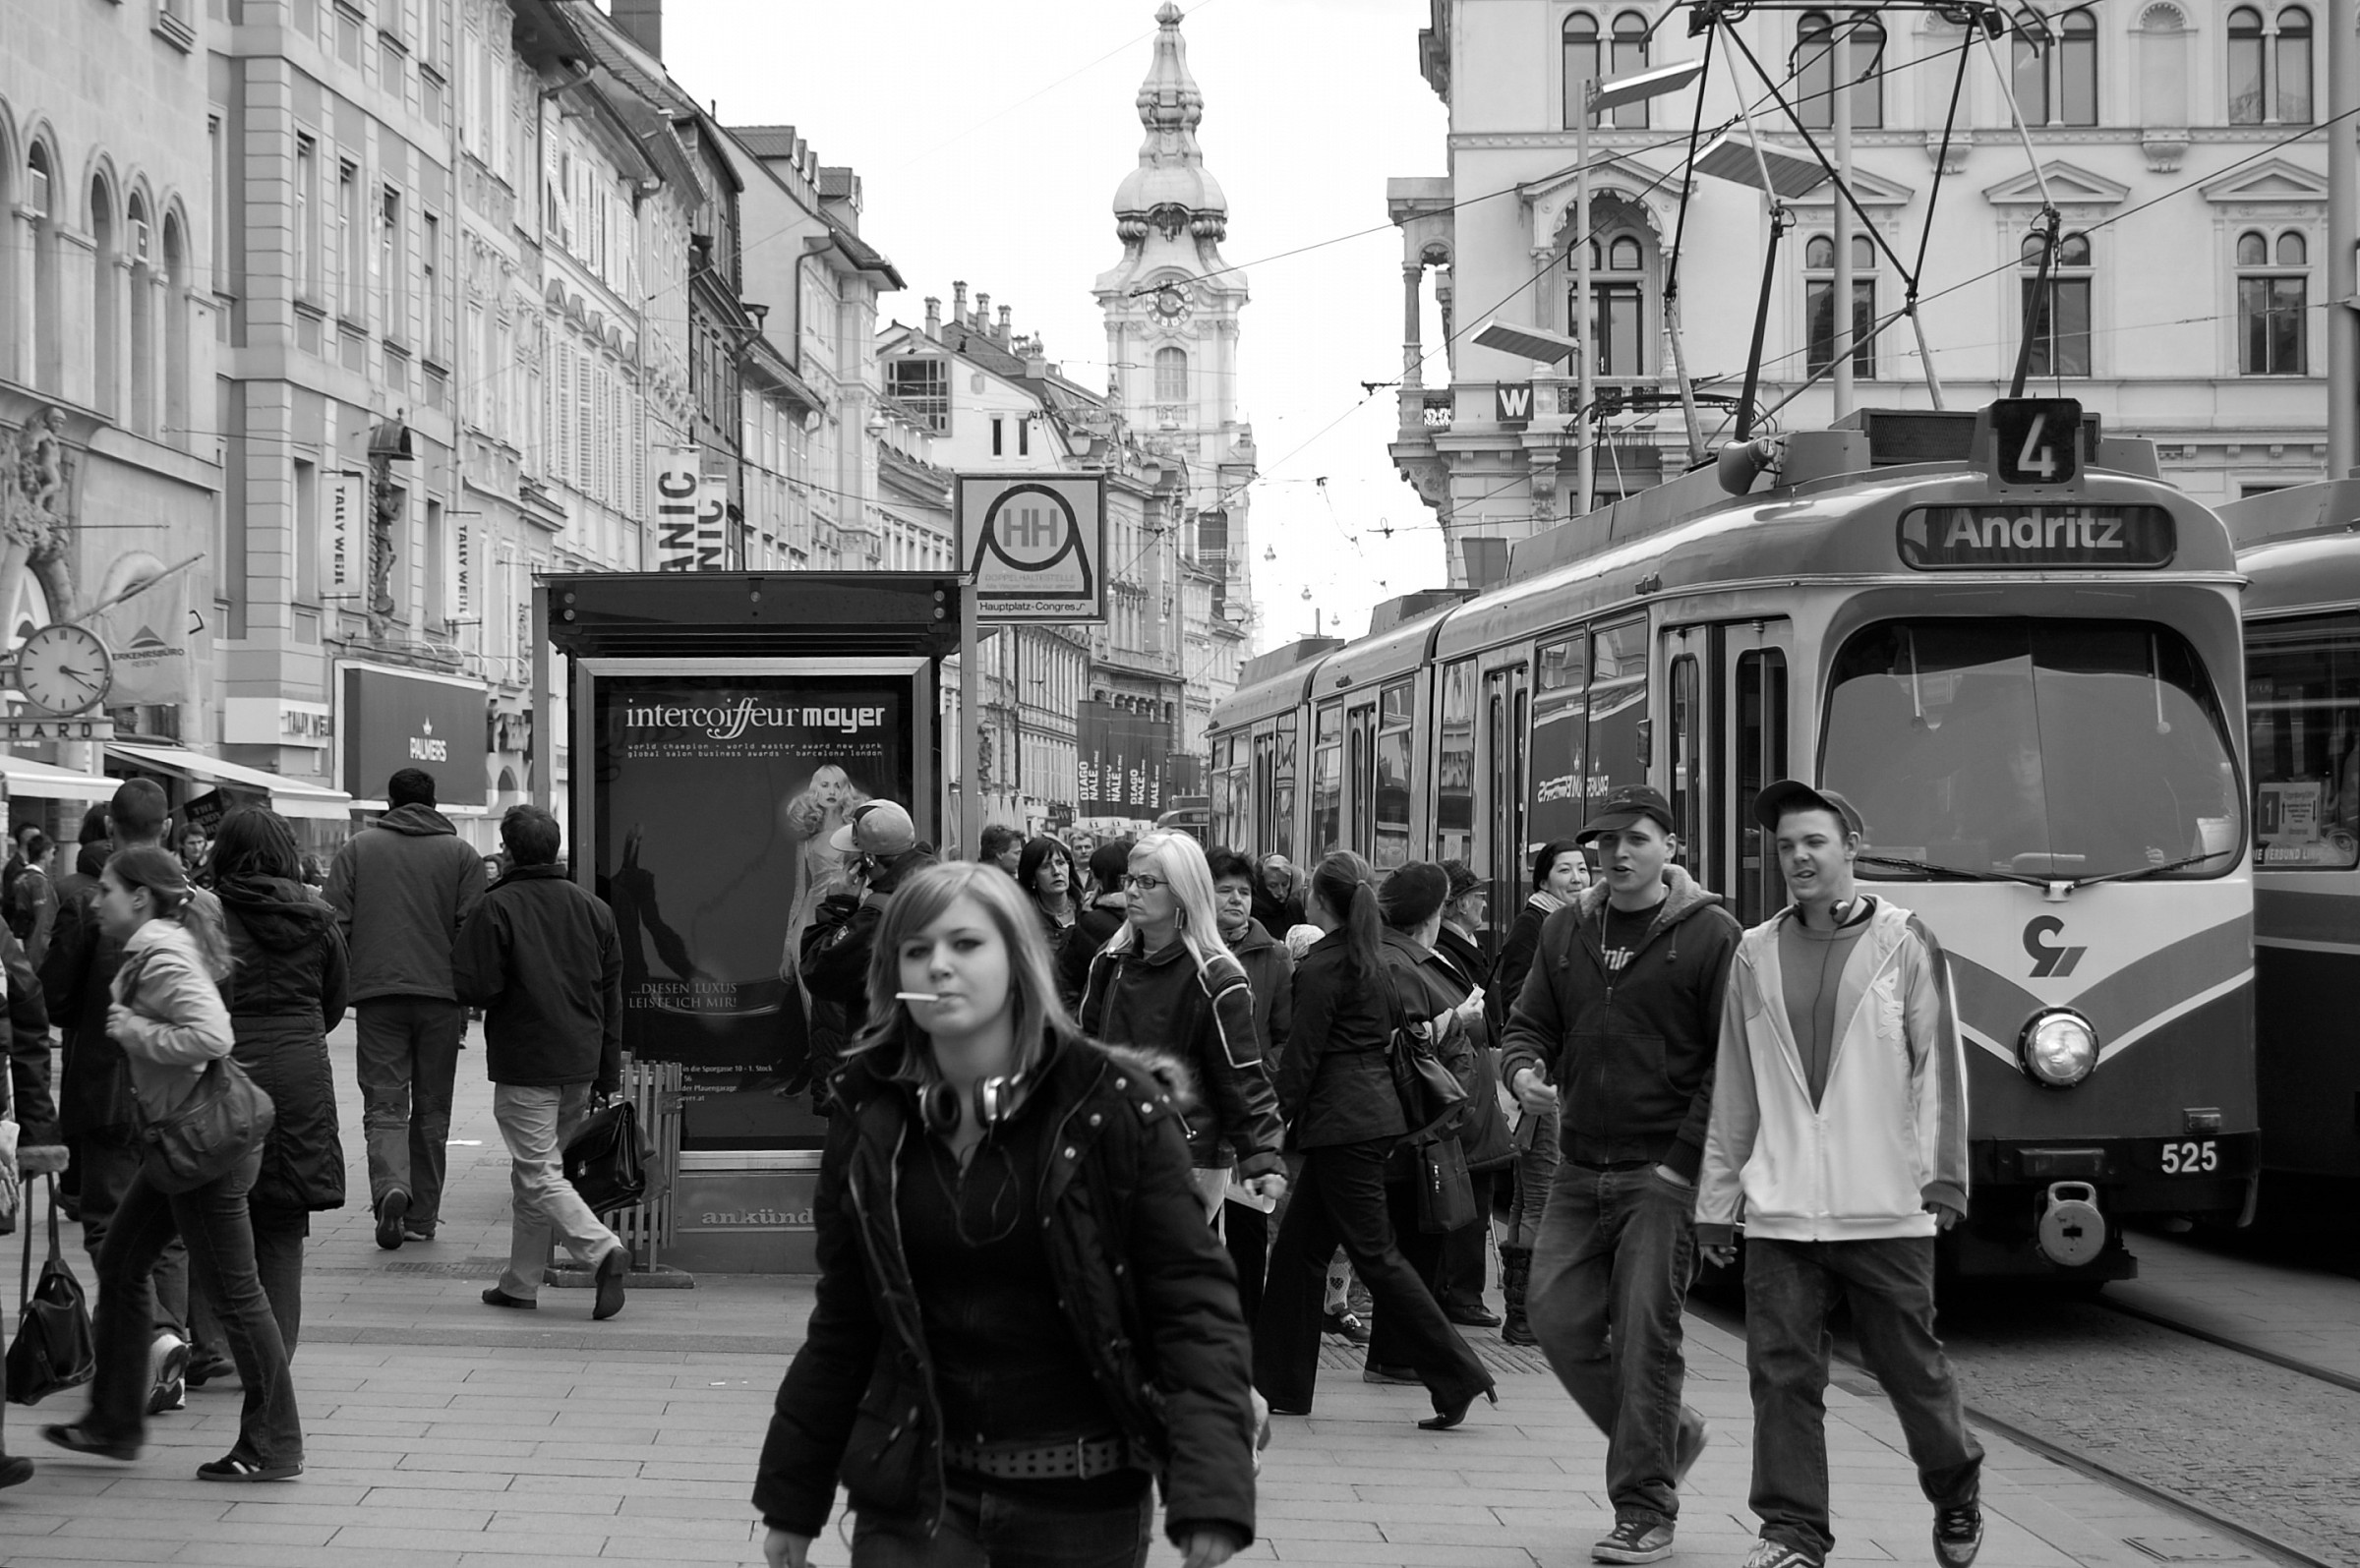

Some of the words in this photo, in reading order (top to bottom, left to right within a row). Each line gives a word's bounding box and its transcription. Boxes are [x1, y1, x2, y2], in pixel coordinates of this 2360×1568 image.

[1499, 388, 1530, 417] W
[2018, 413, 2056, 478] 4
[1003, 508, 1057, 548] HH
[1943, 507, 2124, 549] Andritz
[9, 723, 92, 738] HARD
[625, 697, 799, 739] intercoiffeur
[802, 707, 886, 733] mayer
[409, 737, 447, 762] PALMERS
[663, 743, 709, 752] champion
[859, 742, 882, 751] york
[1089, 770, 1098, 801] NALE
[1111, 772, 1122, 802] NALE
[2266, 800, 2272, 826] 1
[695, 982, 738, 994] LUXUS
[629, 997, 671, 1009] LEISTE
[676, 997, 701, 1009] ICH
[706, 997, 738, 1009] MIR!
[2161, 1140, 2217, 1174] 525
[701, 1207, 814, 1225] ankünd
